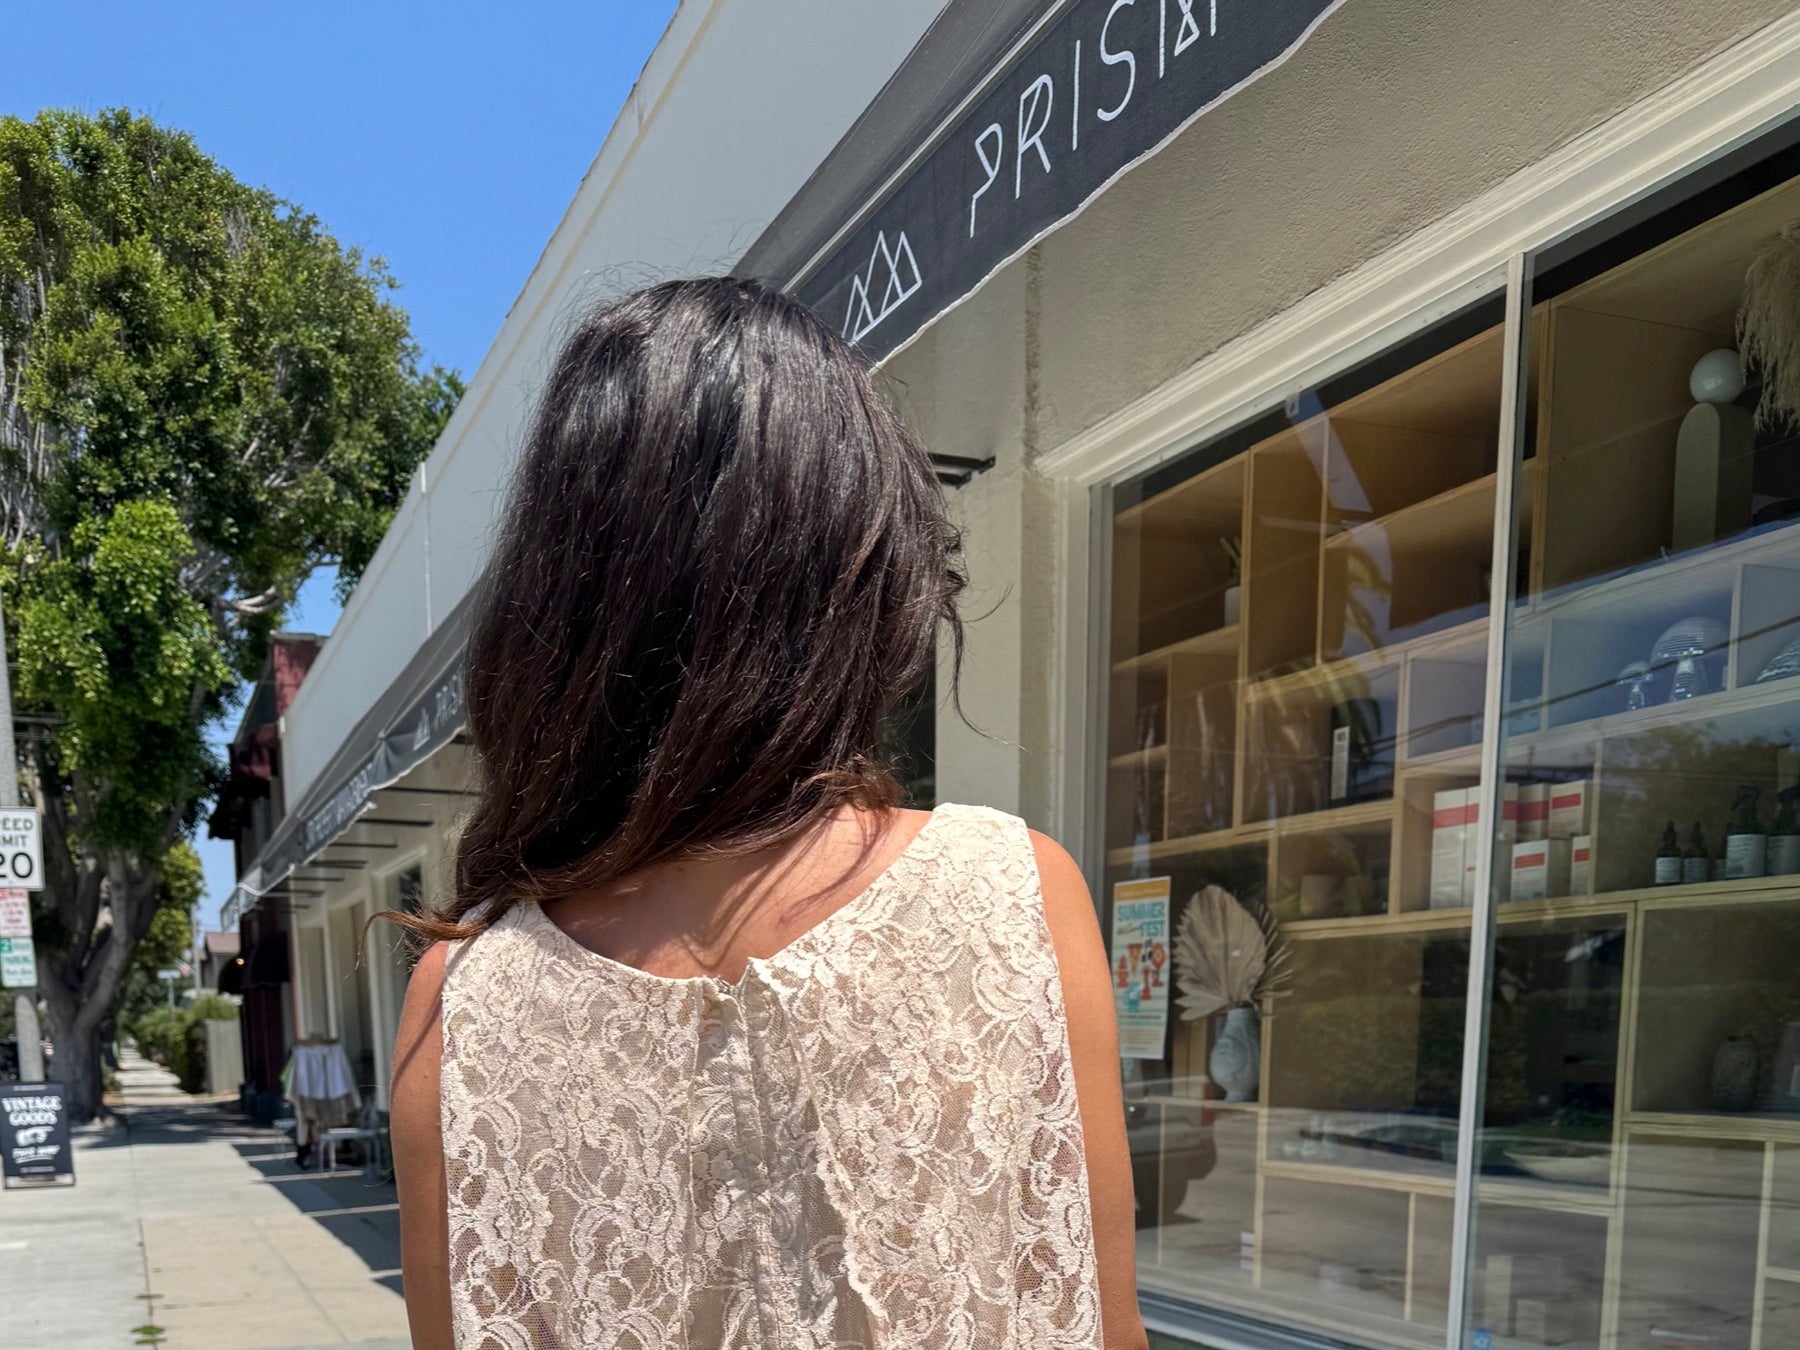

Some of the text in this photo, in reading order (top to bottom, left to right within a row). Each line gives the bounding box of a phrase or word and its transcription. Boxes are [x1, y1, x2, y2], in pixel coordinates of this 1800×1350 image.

[0, 817, 34, 831] EED
[0, 834, 28, 847] MIT
[1117, 901, 1165, 922] SUMMER
[1140, 919, 1165, 938] FEST
[2, 1096, 62, 1112] VINTAGE
[9, 1111, 57, 1126] GOODS
